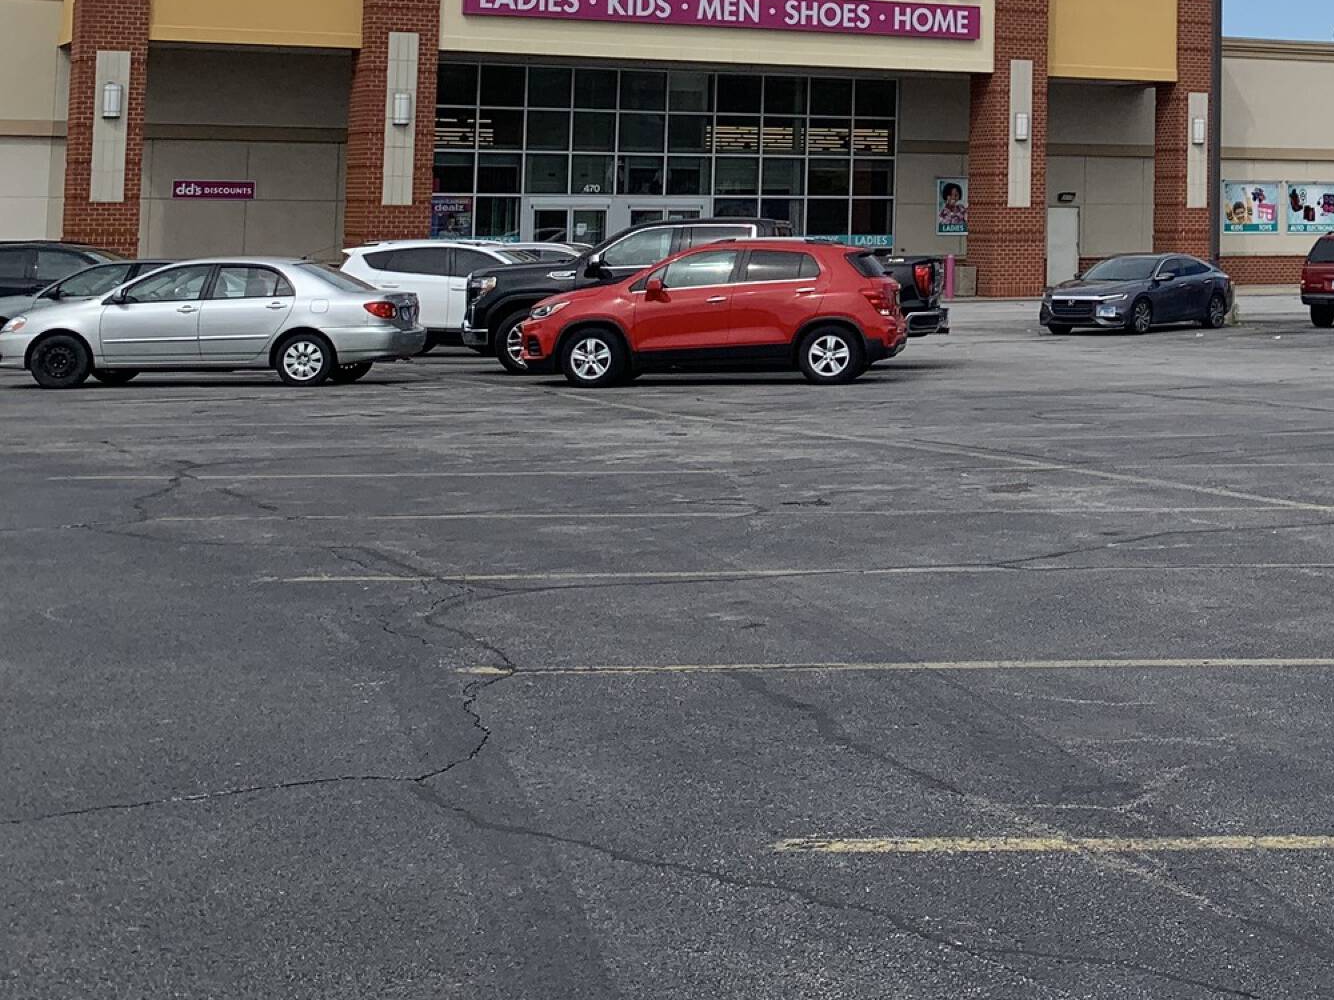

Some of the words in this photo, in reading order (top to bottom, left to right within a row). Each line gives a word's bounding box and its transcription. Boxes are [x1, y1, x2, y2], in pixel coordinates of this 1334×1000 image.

[784, 0, 870, 29] SHOES
[893, 6, 969, 34] HOME
[175, 183, 201, 196] dd's
[203, 187, 252, 195] DISCOUNTS
[583, 184, 600, 192] 470
[855, 235, 888, 245] LADIES
